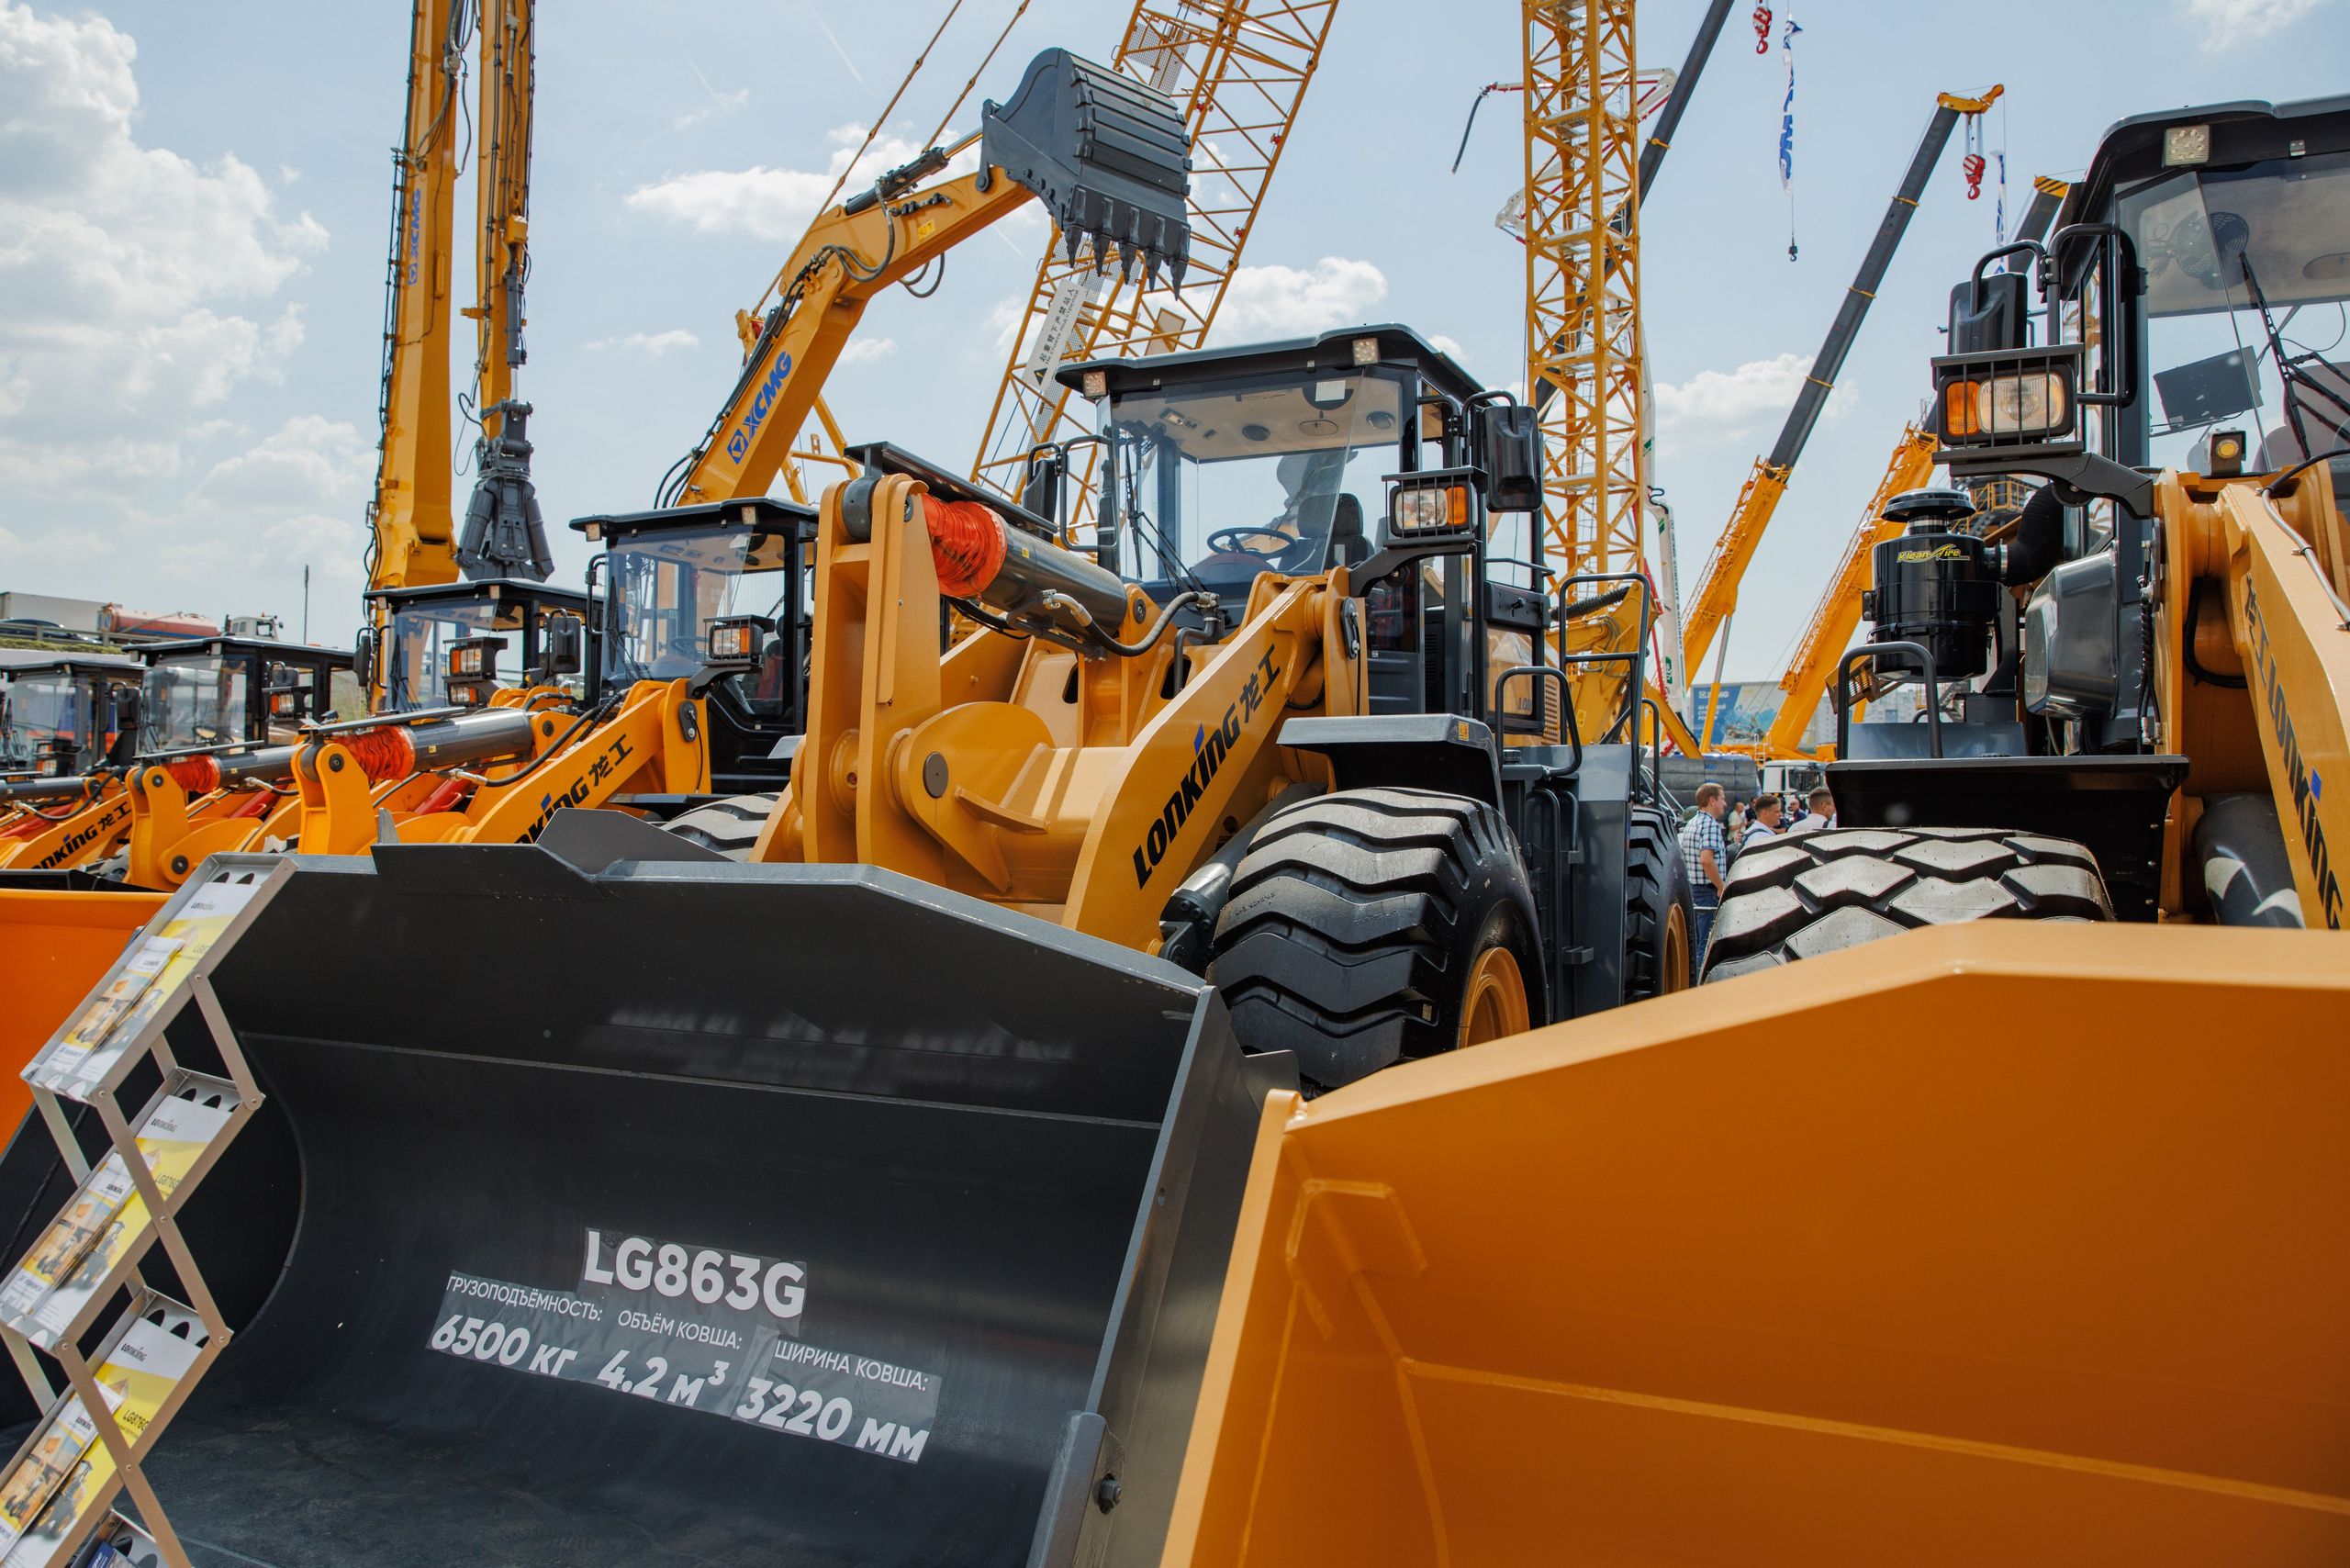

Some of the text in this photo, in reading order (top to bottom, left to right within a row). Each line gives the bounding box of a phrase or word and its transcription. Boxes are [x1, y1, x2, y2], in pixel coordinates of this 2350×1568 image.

[409, 187, 421, 262] XCMG
[1045, 289, 1080, 364] Не стойте под стрелой
[743, 351, 792, 443] XCMG
[1239, 644, 1281, 723] 龙工
[588, 734, 634, 787] 龙工
[97, 801, 132, 832] 龙工
[446, 1275, 603, 1322] ГРУЗОПОДЪЁМНОСТЬ:
[584, 1230, 806, 1318] LG863G
[431, 1314, 531, 1365] 6500
[618, 1309, 743, 1350] ОБЪЁМ КОВША:
[597, 1350, 667, 1399] 4.2
[774, 1339, 929, 1392] ШИРИНА КОВША:
[736, 1377, 853, 1440] 3220
